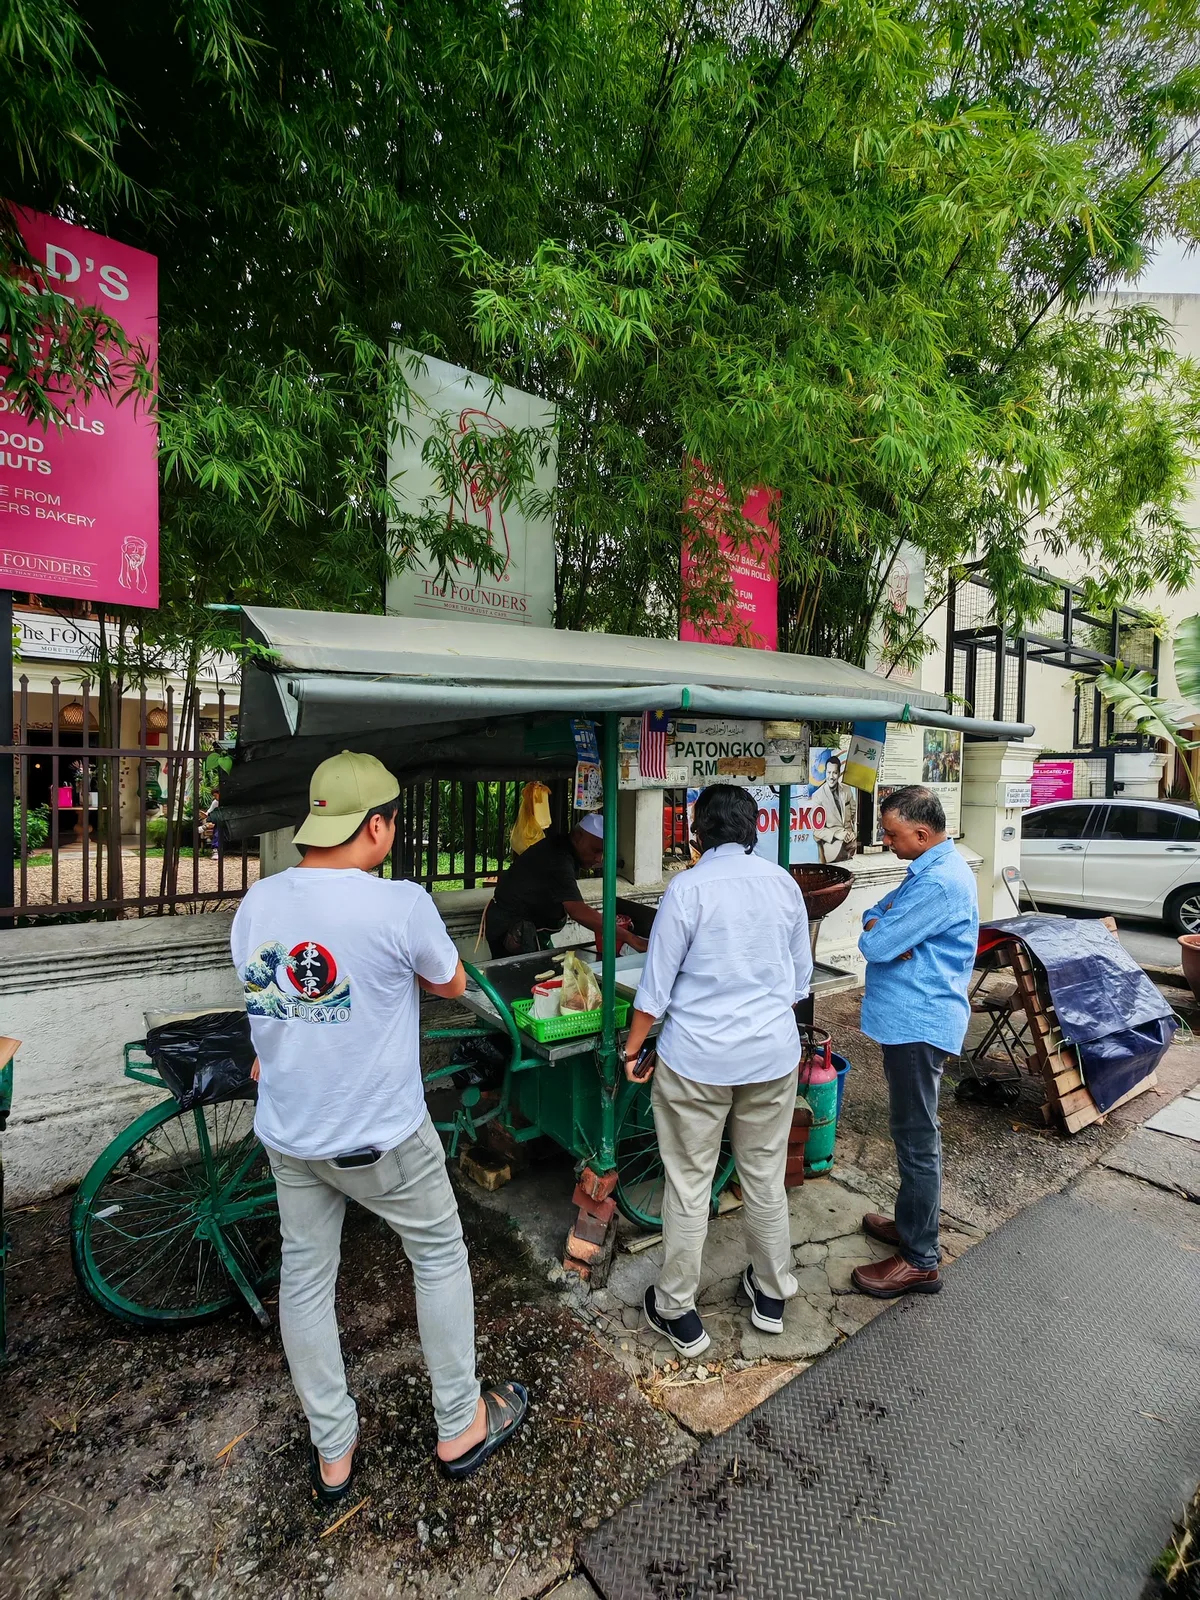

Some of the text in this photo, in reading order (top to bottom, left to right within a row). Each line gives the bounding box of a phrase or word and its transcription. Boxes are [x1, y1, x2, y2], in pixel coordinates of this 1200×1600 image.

[44, 243, 130, 301] D'S
[35, 409, 105, 436] OLLS
[14, 487, 61, 506] FROM
[35, 507, 97, 528] BAKERY
[3, 553, 92, 577] FOUNDERS
[421, 579, 528, 612] The FOUNDERS
[740, 590, 753, 601] FUN
[443, 602, 459, 610] MORE
[460, 605, 475, 613] THAN
[476, 608, 489, 616] JUST
[736, 601, 757, 613] SPACE
[675, 741, 765, 758] PATONGKO
[693, 760, 718, 776] RM
[756, 806, 826, 833] ONGKO
[794, 834, 809, 842] 1957
[300, 942, 321, 997] 東京
[284, 1002, 351, 1023] TOKYO
